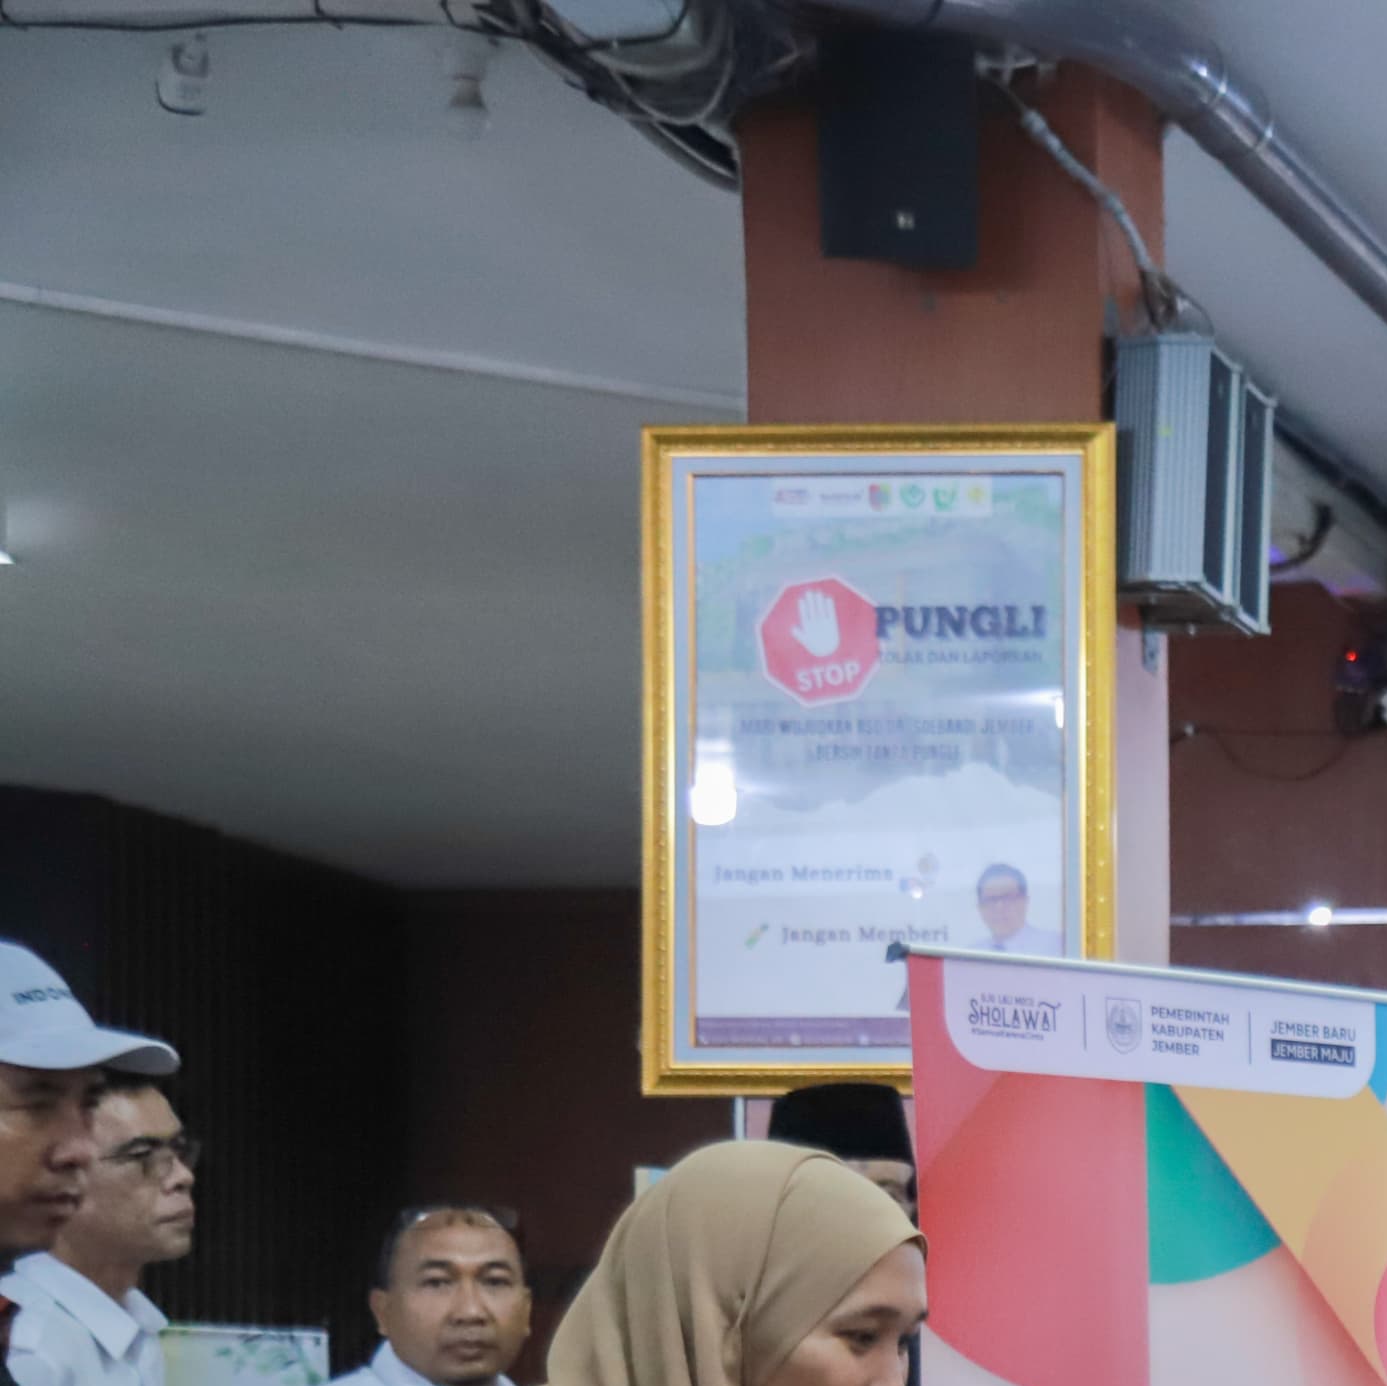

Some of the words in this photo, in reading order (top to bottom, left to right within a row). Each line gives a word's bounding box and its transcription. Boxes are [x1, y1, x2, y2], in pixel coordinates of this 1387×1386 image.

[876, 605, 1047, 639] PUNGLI
[796, 660, 862, 693] STOP
[713, 865, 784, 886] Jangan
[790, 865, 893, 882] Menerima
[781, 925, 848, 945] Jangan
[858, 924, 949, 942] Memberi
[968, 998, 1061, 1032] SHOLAWAT
[1151, 1006, 1230, 1025] PEMERINTAH
[1151, 1023, 1225, 1042] KABUPATEN
[1270, 1020, 1320, 1038] JEMBER
[1323, 1025, 1357, 1042] BARU
[1152, 1040, 1201, 1057] JEMBER
[1273, 1044, 1320, 1062] JEMBER
[1321, 1047, 1355, 1064] MAJU
